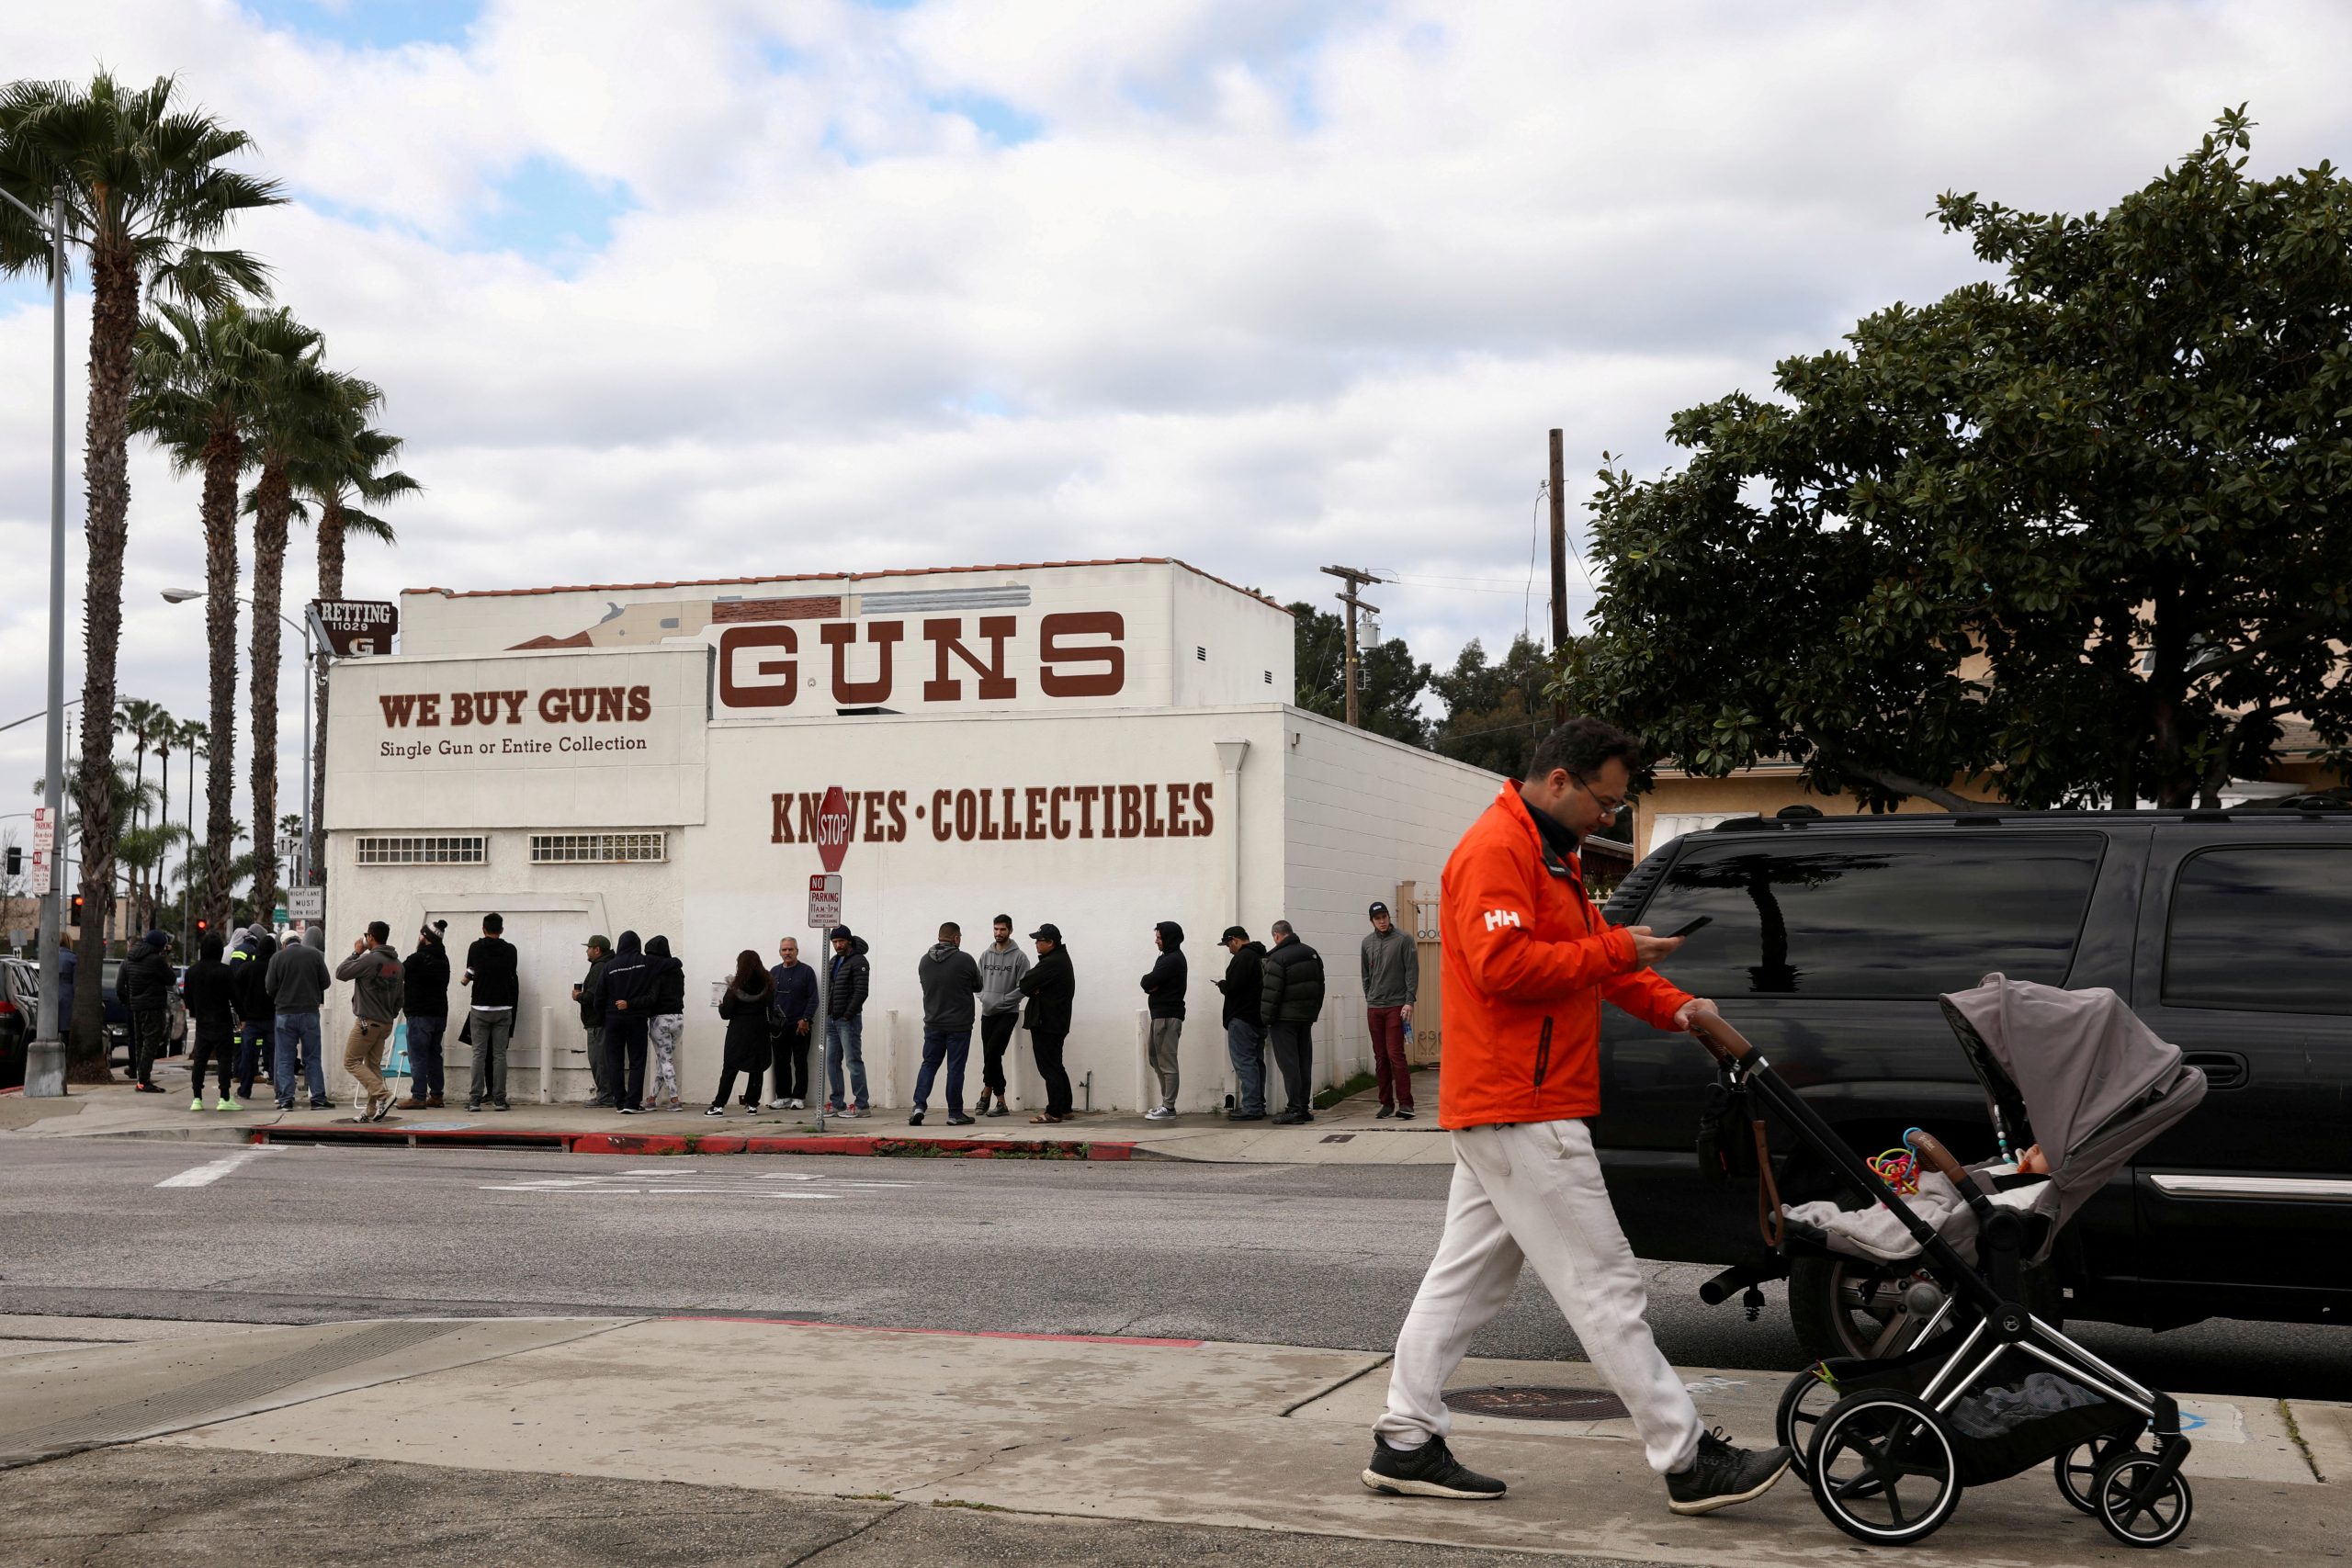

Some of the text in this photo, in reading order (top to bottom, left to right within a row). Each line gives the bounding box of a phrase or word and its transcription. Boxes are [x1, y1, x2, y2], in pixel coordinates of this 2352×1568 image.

[321, 602, 391, 624] RETTING
[332, 622, 368, 632] 11029
[719, 611, 1125, 708] GUNS
[379, 685, 651, 728] WE BUY GUNS
[380, 735, 648, 760] Single Gun or Entire Collection
[35, 810, 43, 819] NO
[771, 782, 1215, 844] KNVES COLLECTIBLES
[820, 814, 848, 846] STOP
[34, 853, 41, 863] NO
[812, 877, 823, 889] NO
[812, 892, 839, 903] PARKING
[1484, 909, 1521, 932] HH
